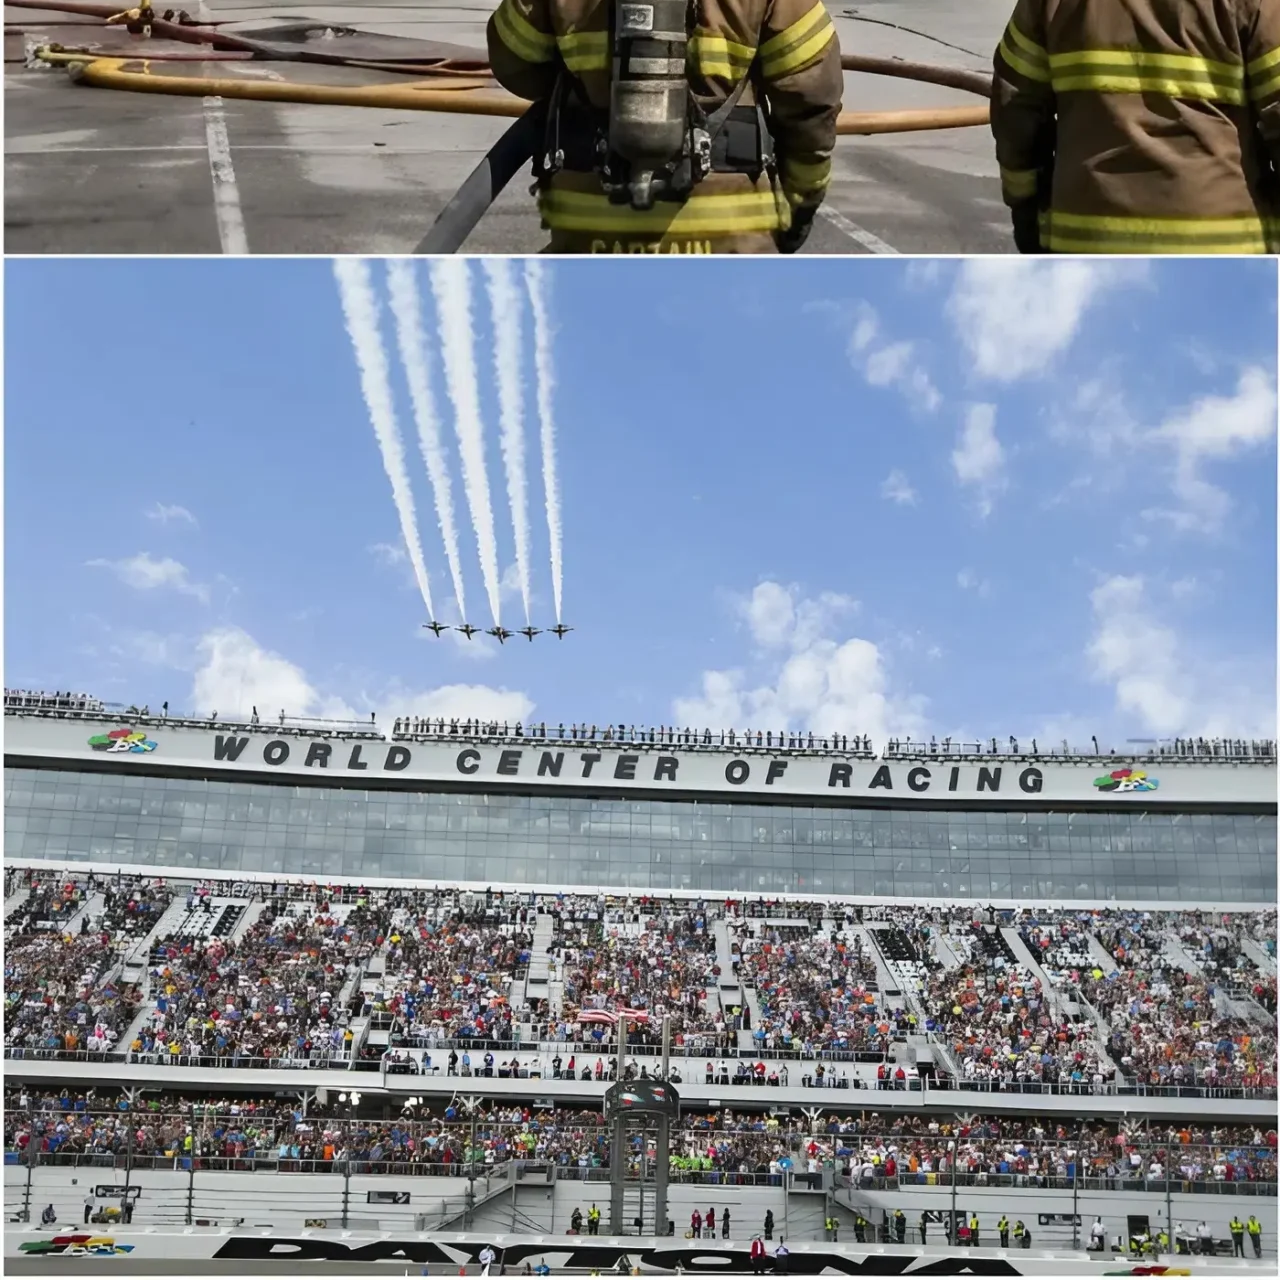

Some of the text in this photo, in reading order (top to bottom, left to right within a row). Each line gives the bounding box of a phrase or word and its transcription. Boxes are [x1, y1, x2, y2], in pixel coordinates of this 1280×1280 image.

[214, 735, 1044, 794] WORLD CENTER OF RACING
[211, 1236, 1024, 1276] DAYTONA
